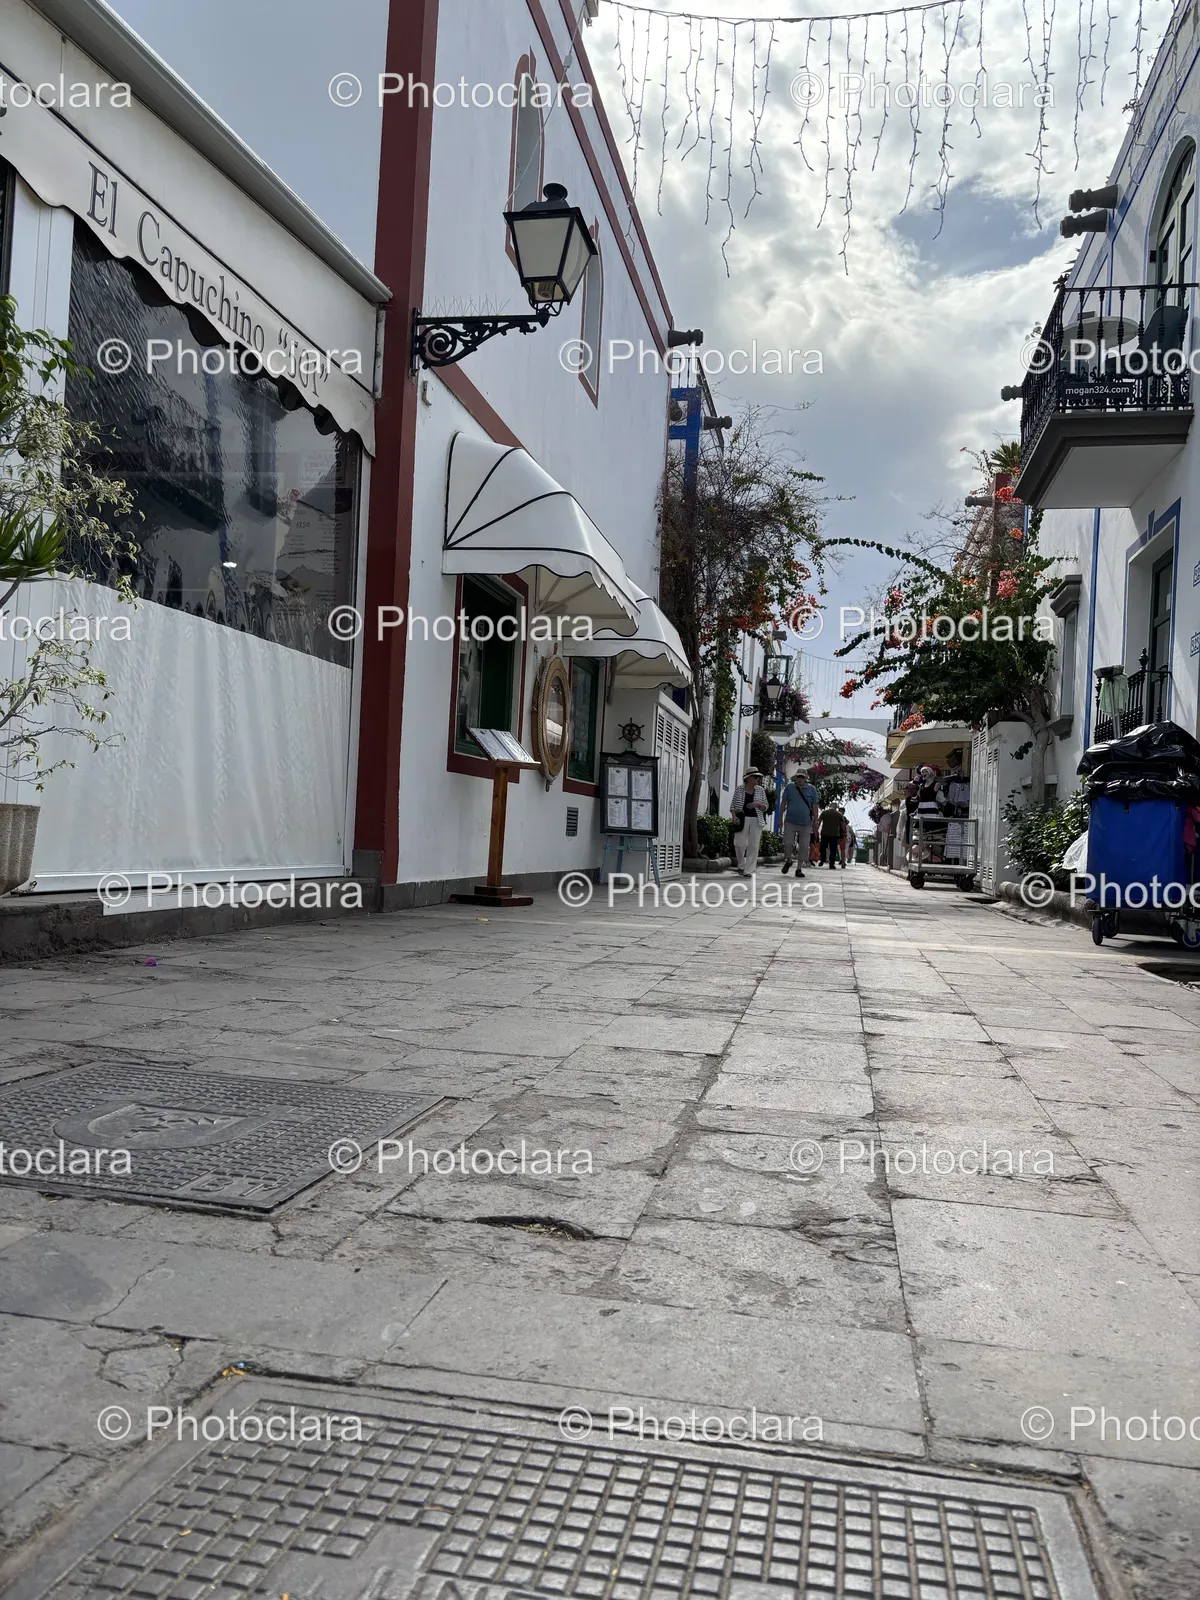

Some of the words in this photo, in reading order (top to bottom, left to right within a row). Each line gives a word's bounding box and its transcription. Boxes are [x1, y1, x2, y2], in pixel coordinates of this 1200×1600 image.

[86, 161, 118, 238] El
[136, 211, 265, 353] Capuchino
[1065, 385, 1130, 396] mogan324.com
